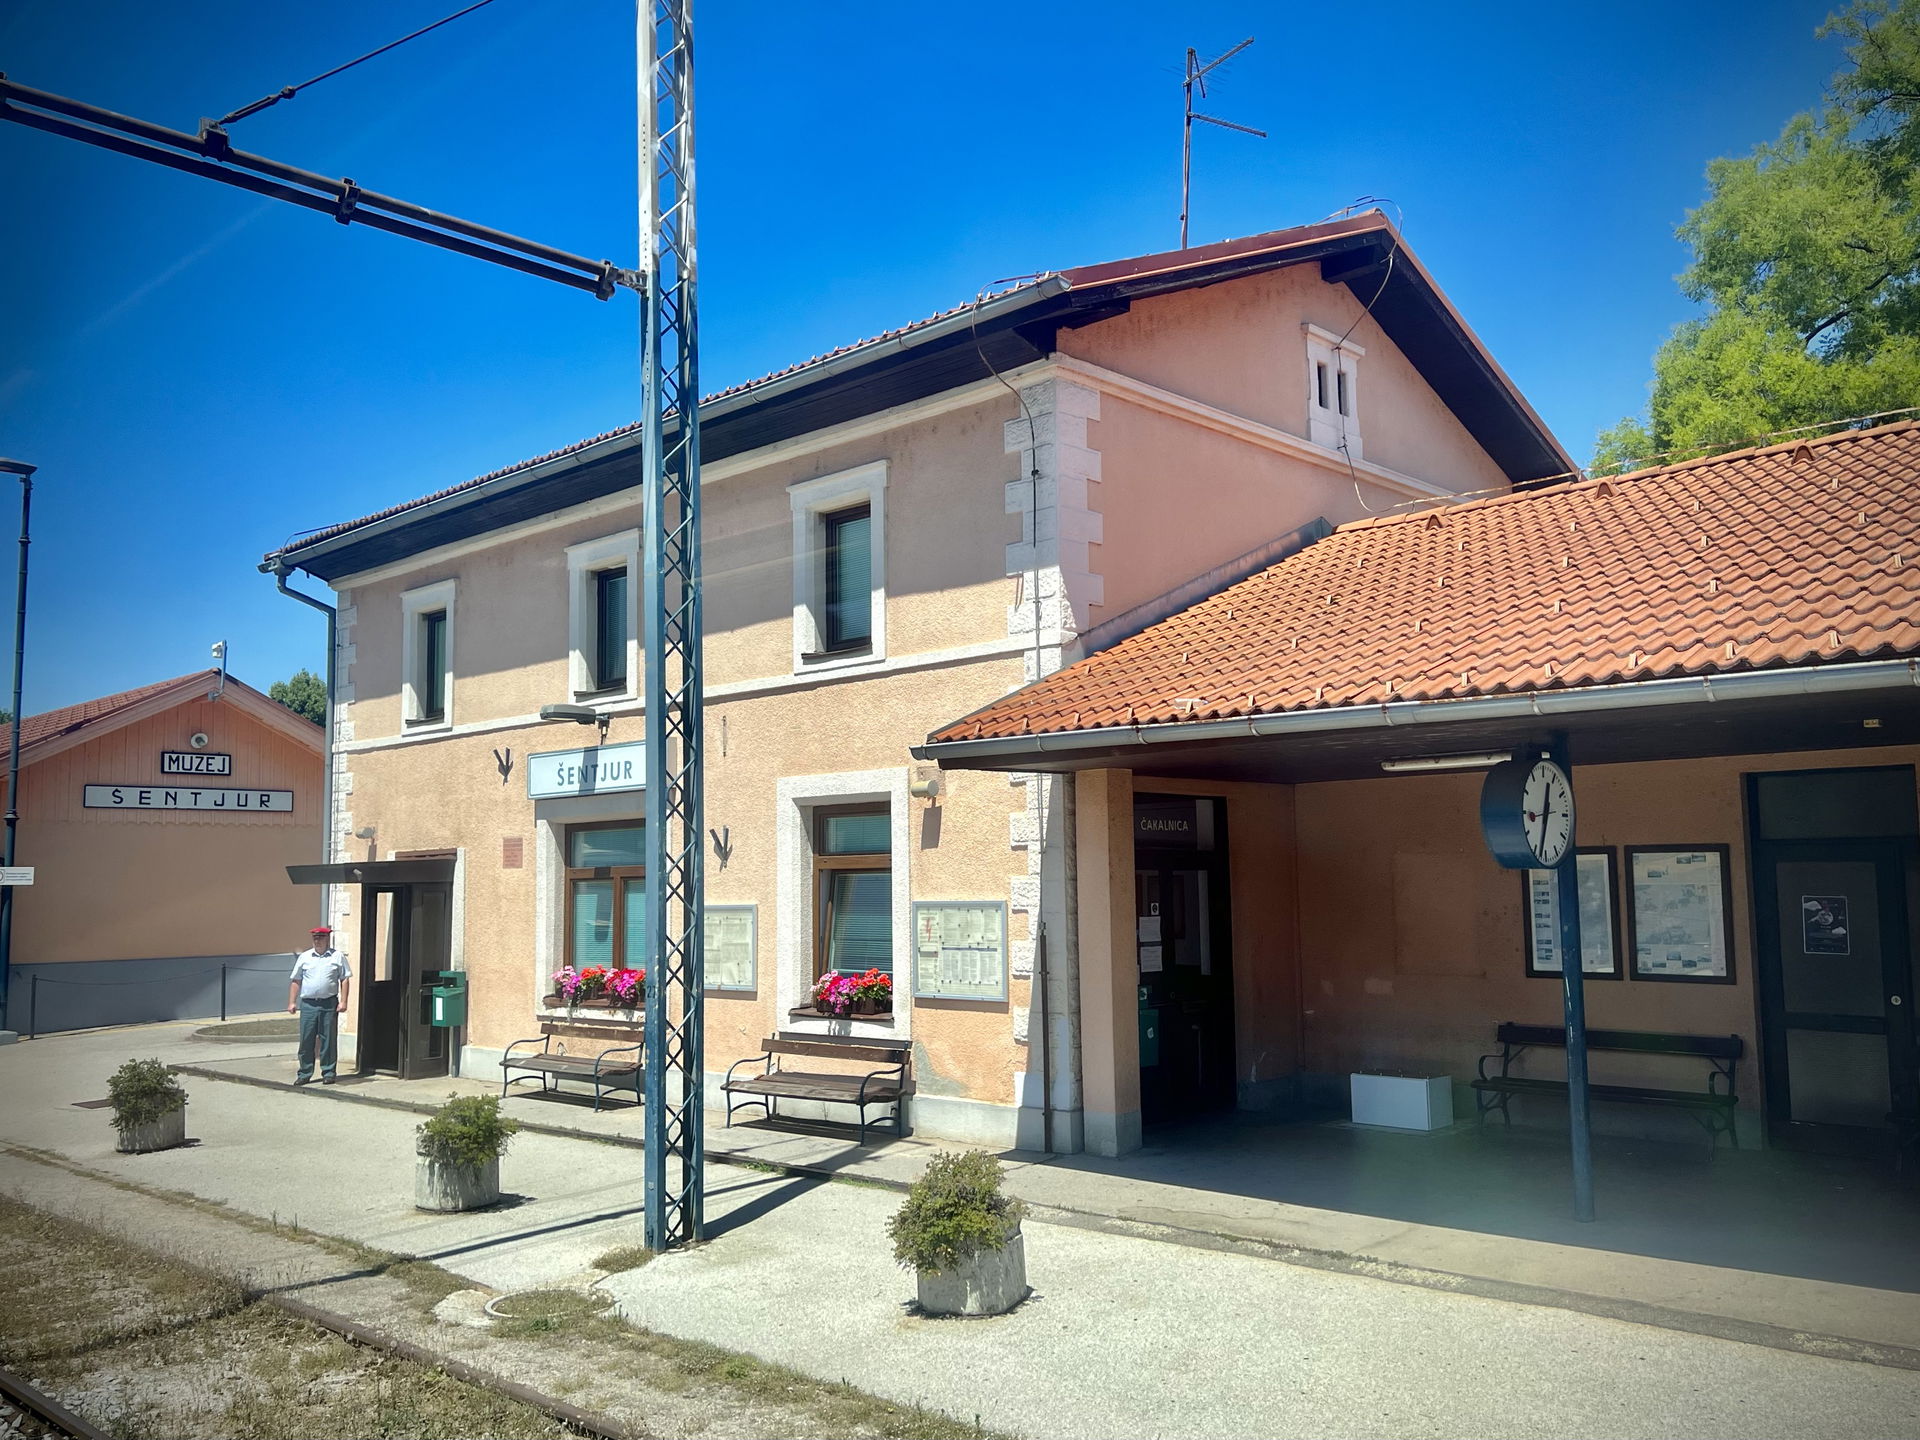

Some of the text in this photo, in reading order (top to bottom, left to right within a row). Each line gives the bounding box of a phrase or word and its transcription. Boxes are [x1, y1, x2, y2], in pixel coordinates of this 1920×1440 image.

[168, 754, 226, 773] MUZEJ
[557, 760, 632, 786] ŠENTJUR
[1140, 816, 1189, 831] ČAKALNICA
